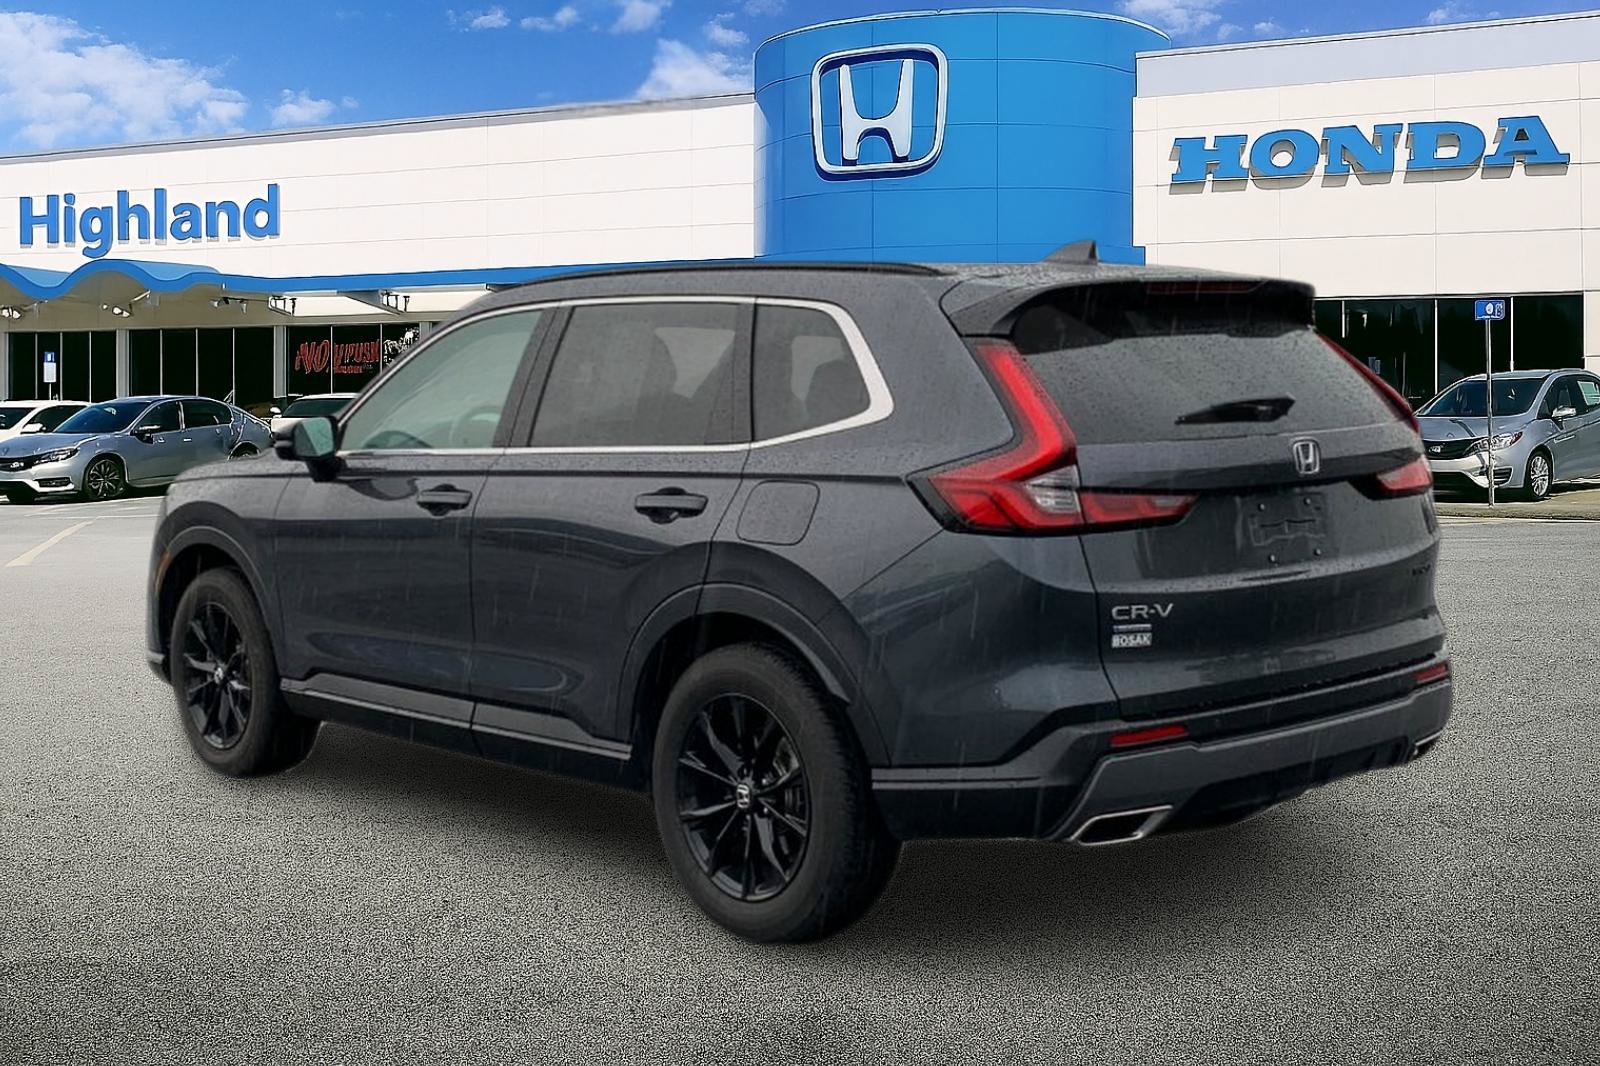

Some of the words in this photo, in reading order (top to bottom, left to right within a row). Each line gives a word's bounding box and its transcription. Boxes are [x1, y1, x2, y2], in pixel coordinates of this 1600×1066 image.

[1170, 115, 1570, 190] HONDA
[19, 183, 280, 258] Highland
[1111, 603, 1174, 620] CR-V
